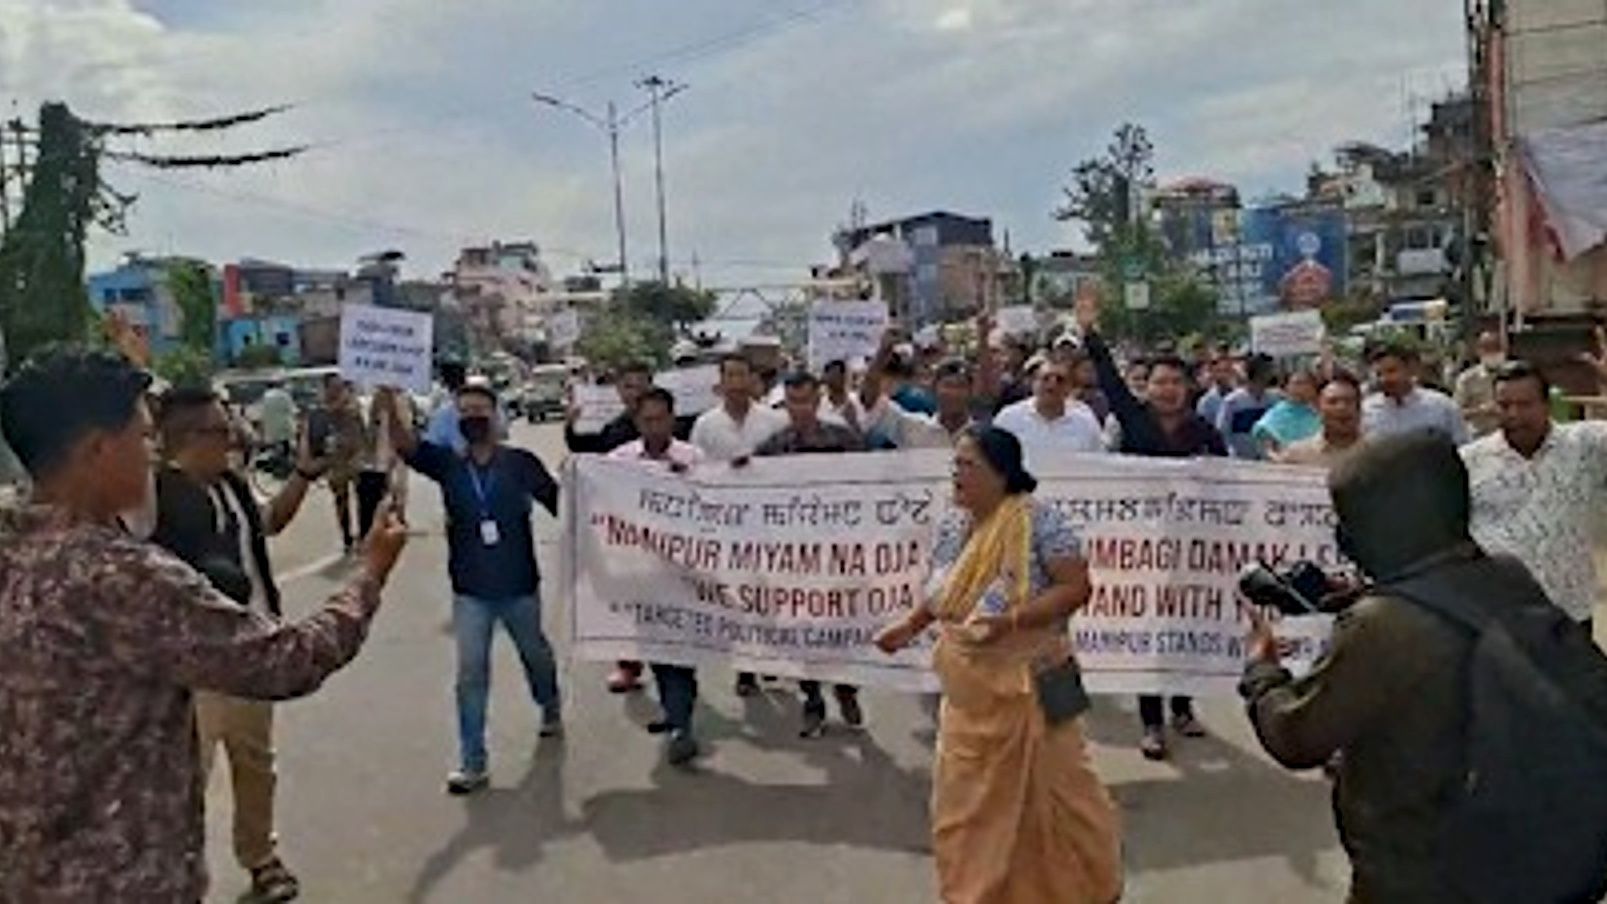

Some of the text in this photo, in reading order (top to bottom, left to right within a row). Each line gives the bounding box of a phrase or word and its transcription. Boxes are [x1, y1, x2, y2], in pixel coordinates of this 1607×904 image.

[728, 541, 822, 574] MIYAM
[829, 541, 867, 575] NA
[875, 538, 921, 574] OJA
[1087, 537, 1182, 571] MBAGI
[739, 584, 857, 619] SUPPORT
[868, 581, 915, 616] OJA
[1156, 584, 1222, 620] WITH
